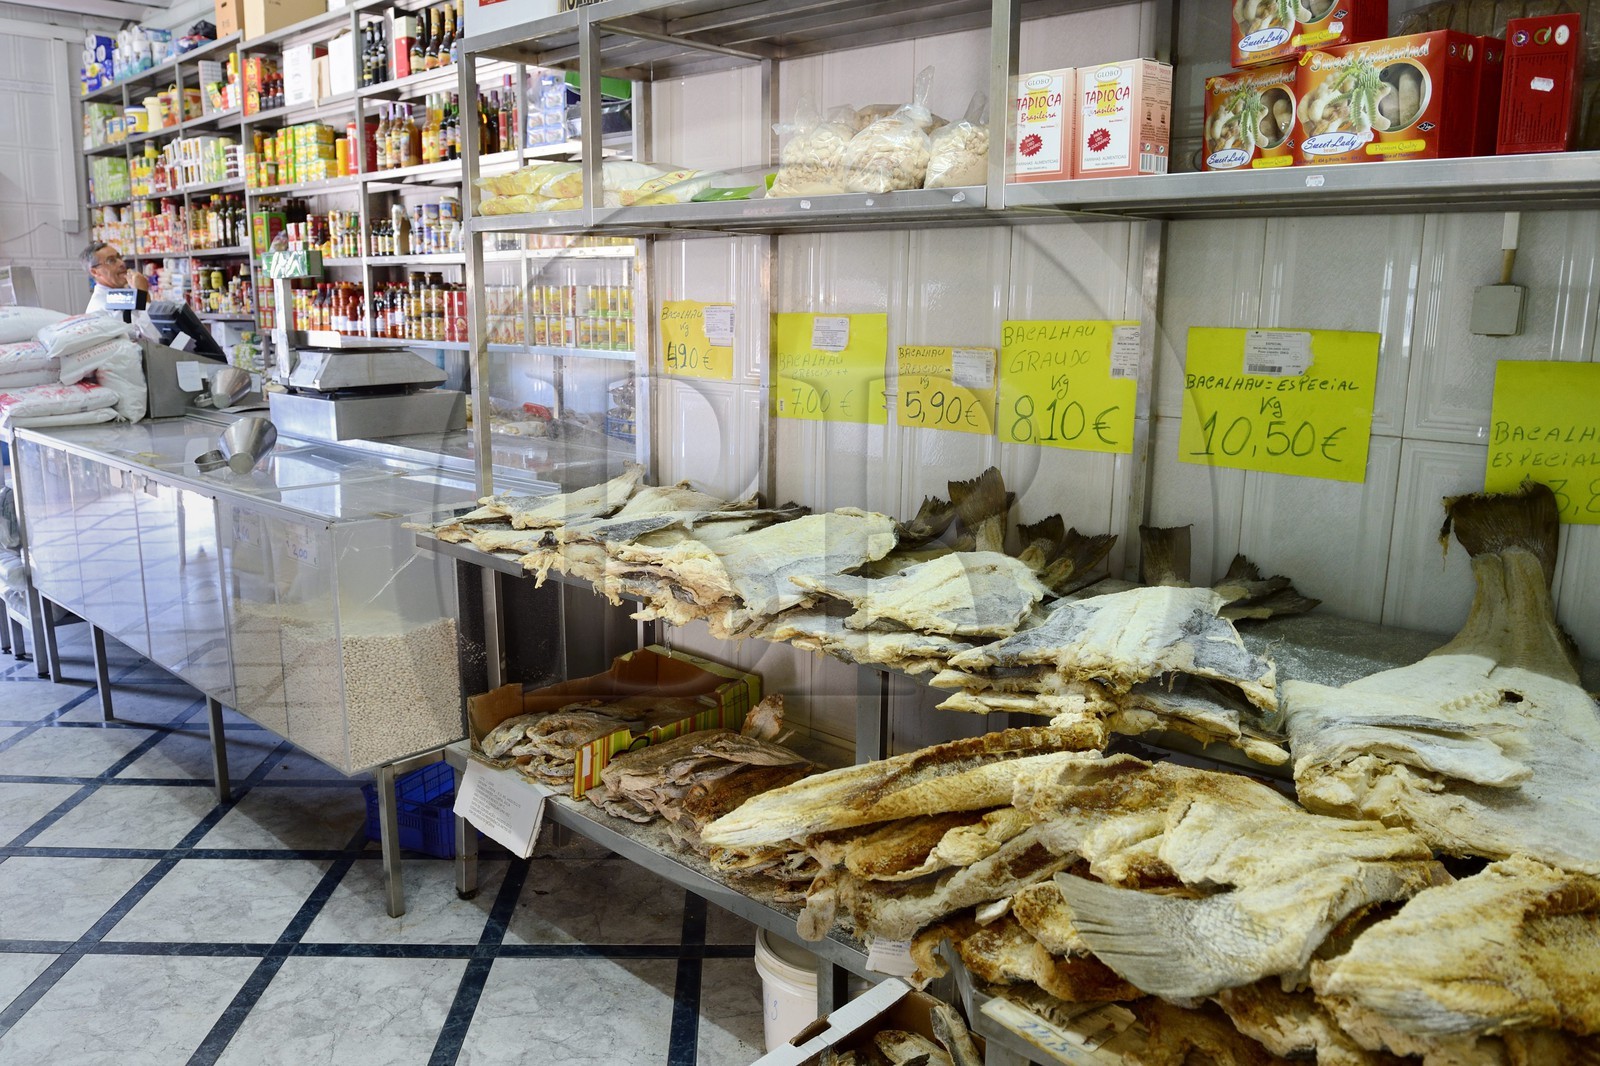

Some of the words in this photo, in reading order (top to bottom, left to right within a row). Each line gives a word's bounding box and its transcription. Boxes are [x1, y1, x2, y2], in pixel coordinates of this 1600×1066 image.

[1240, 35, 1264, 49] Sweet
[1263, 31, 1285, 44] Lady
[1310, 51, 1355, 72] Sweet
[1027, 79, 1050, 87] GLOBO
[1097, 70, 1119, 79] GLOBO
[1016, 93, 1062, 111] TAPIOCA
[1085, 86, 1130, 105] TAPIOCA
[1020, 111, 1057, 123] Brasileira
[1303, 138, 1333, 151] Sweet
[1331, 136, 1357, 147] Lady
[1208, 154, 1229, 165] Sweet
[1228, 152, 1247, 163] Lady
[1002, 325, 1096, 348] BACALHAU
[779, 352, 844, 371] BACALHAU
[899, 347, 946, 359] BACALHAU
[1009, 349, 1091, 374] GRAUDO
[1051, 373, 1069, 400] Kg
[792, 388, 831, 416] 7,00
[1260, 396, 1283, 419] Kg
[1494, 421, 1600, 446] BACALH
